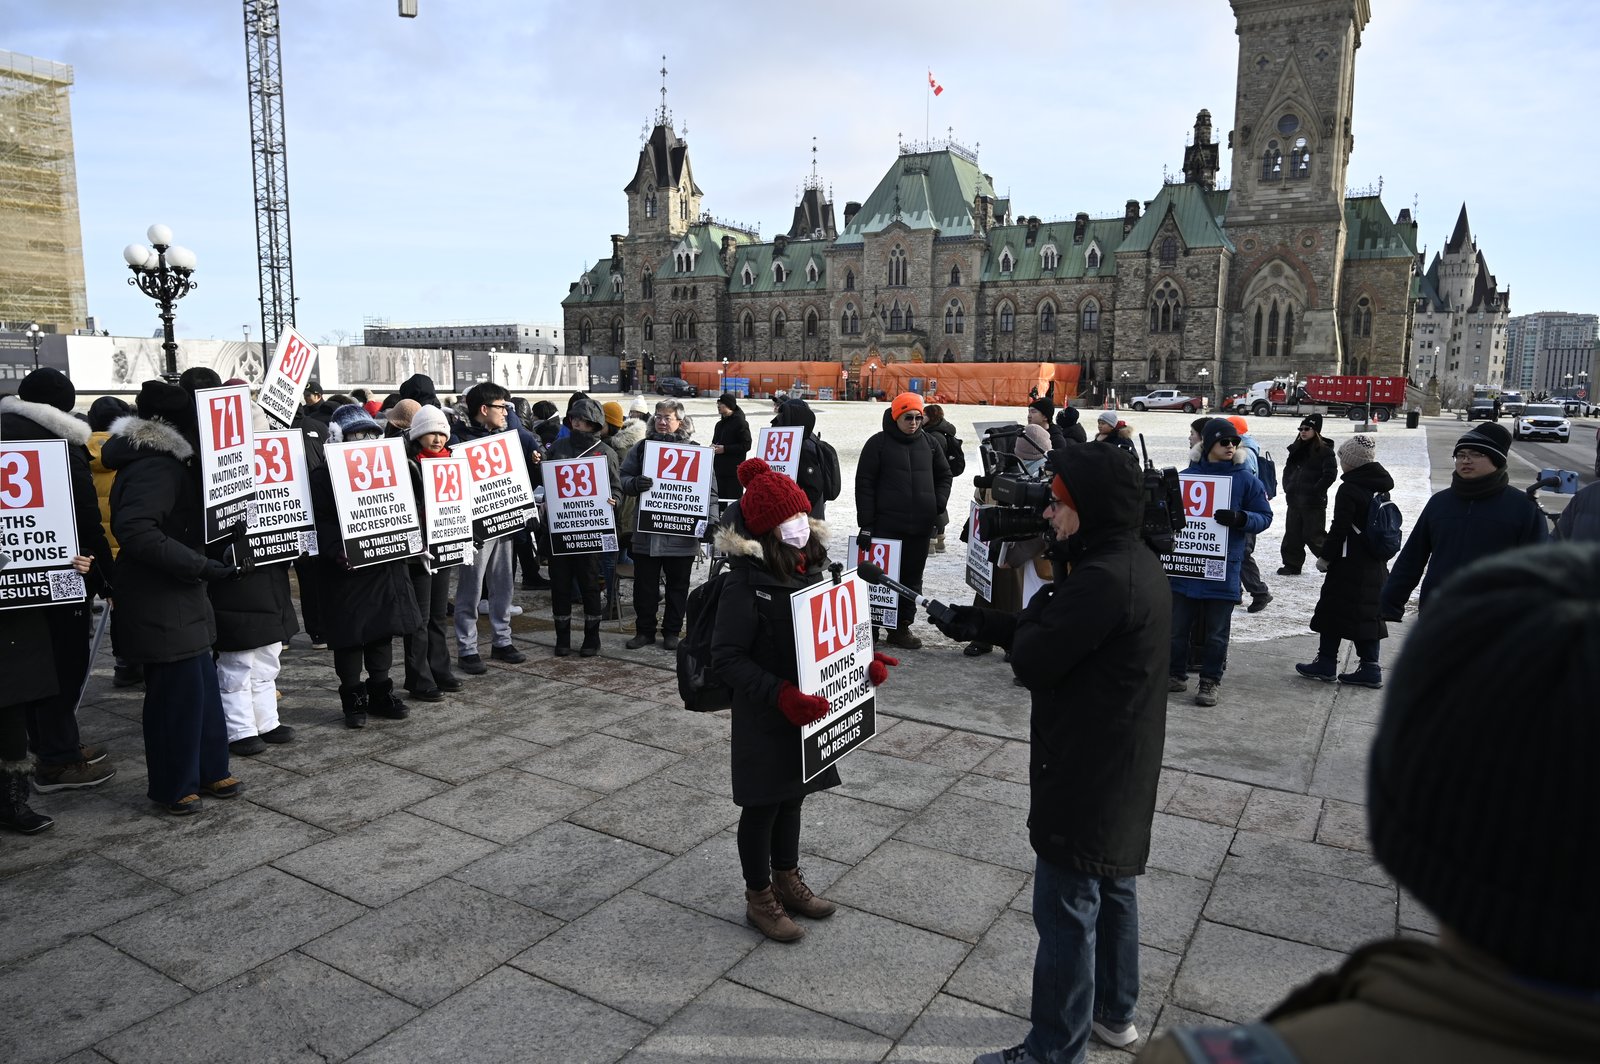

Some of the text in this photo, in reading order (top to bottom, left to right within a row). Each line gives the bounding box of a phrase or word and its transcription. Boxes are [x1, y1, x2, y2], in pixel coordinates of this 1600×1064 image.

[282, 339, 307, 381] 30
[277, 376, 294, 396] MONTHS
[268, 384, 294, 408] WAITING FOR
[271, 399, 293, 420] RESPONSE
[214, 396, 241, 449] 71
[767, 432, 790, 461] 35
[218, 451, 243, 467] MONTHS
[471, 440, 507, 480] 39
[661, 448, 696, 480] 27
[212, 463, 250, 484] WAITING FOR
[350, 446, 392, 490] 34
[0, 451, 33, 508] 3
[436, 464, 460, 502] 23
[479, 477, 512, 493] MONTHS
[560, 464, 592, 497] 33
[209, 477, 253, 501] IRCC RESPONSE
[473, 484, 522, 505] WAITING FOR
[660, 483, 693, 493] MONTHS
[357, 492, 395, 507] MONTHS
[471, 492, 529, 516] IRCC RESPONSE
[563, 500, 594, 510] MONTHS
[651, 491, 700, 503] WAITING FOR
[216, 499, 248, 520] NO TIMELINES
[256, 499, 302, 514] ITING FOR
[350, 503, 406, 520] WAITING FOR
[438, 505, 461, 515] MONTHS
[556, 509, 604, 520] WAITING FOR
[645, 500, 703, 513] IRCC RESPONSE
[0, 515, 36, 529] THS
[218, 520, 227, 530] NO
[259, 511, 308, 527] RESPONSE
[347, 514, 413, 534] IRCC RESPONSE
[434, 515, 467, 528] WAITING FOR
[482, 508, 524, 527] NO TIMELINES
[487, 516, 524, 534] NO RESULTS
[553, 518, 609, 530] IRCC RESPONSE
[651, 513, 695, 524] NO TIMELINES
[1185, 521, 1207, 530] NTHS
[431, 525, 470, 539] IRCC RESPONSE
[653, 521, 691, 531] NO RESULTS
[24, 530, 57, 545] FOR
[248, 531, 299, 547] NO TIMELINE
[359, 532, 408, 549] NO TIMELINES
[562, 532, 603, 542] NO TIMELINES
[566, 540, 602, 549] NO RESULTS
[1198, 533, 1216, 541] FOR
[4, 546, 69, 562] PONSE
[253, 541, 299, 558] NO RESULTS
[363, 543, 406, 559] NO RESULTS
[437, 545, 445, 554] NO
[1174, 541, 1221, 552] RESPONSE
[439, 554, 446, 562] NO
[1160, 554, 1208, 565] NO TIMELINE
[1162, 562, 1205, 573] NO RESULTS
[0, 572, 49, 586] MELINE
[1, 584, 49, 600] ESULTS
[869, 594, 894, 604] SPONSE
[878, 587, 891, 595] FOR
[818, 585, 853, 655] 40
[820, 653, 855, 683] MONTHS
[849, 665, 865, 688] FOR
[828, 680, 870, 716] RESPONSE
[817, 732, 828, 748] NO
[828, 709, 863, 740] TIMELINES
[821, 725, 861, 761] NO RESULTS
